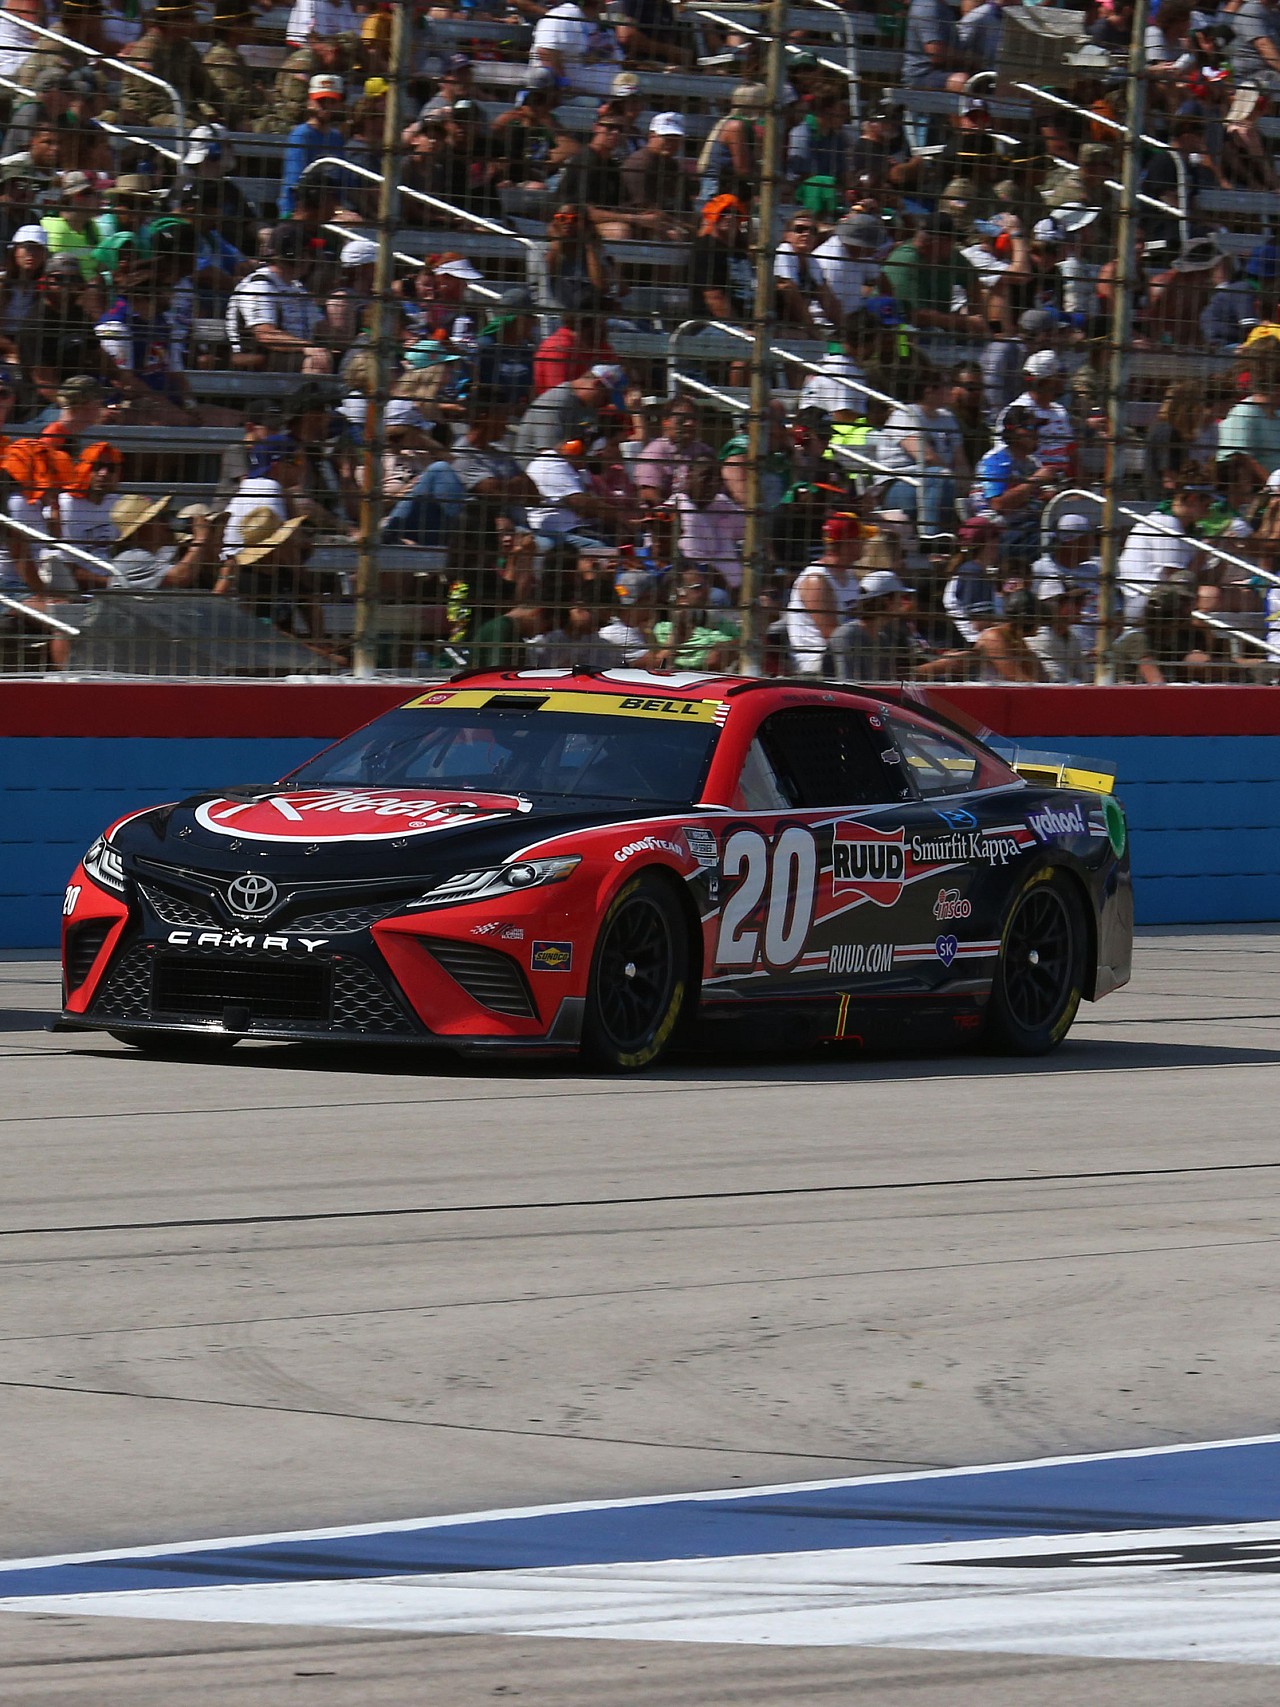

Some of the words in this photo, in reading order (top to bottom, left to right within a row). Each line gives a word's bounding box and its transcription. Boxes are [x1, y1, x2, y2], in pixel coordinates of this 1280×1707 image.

[618, 697, 700, 715] BELL
[1028, 804, 1086, 840] yahoo!
[613, 836, 683, 862] GOODYEAR
[833, 844, 904, 879] RUUD
[912, 833, 969, 861] Smurfit
[968, 833, 1023, 866] Kappa
[62, 885, 82, 915] 20
[715, 827, 817, 965] 20
[935, 889, 972, 921] insco
[167, 931, 330, 952] CAMRY
[939, 942, 953, 957] SK
[534, 951, 570, 962] SUNOCO
[828, 944, 893, 973] RUUD.COM
